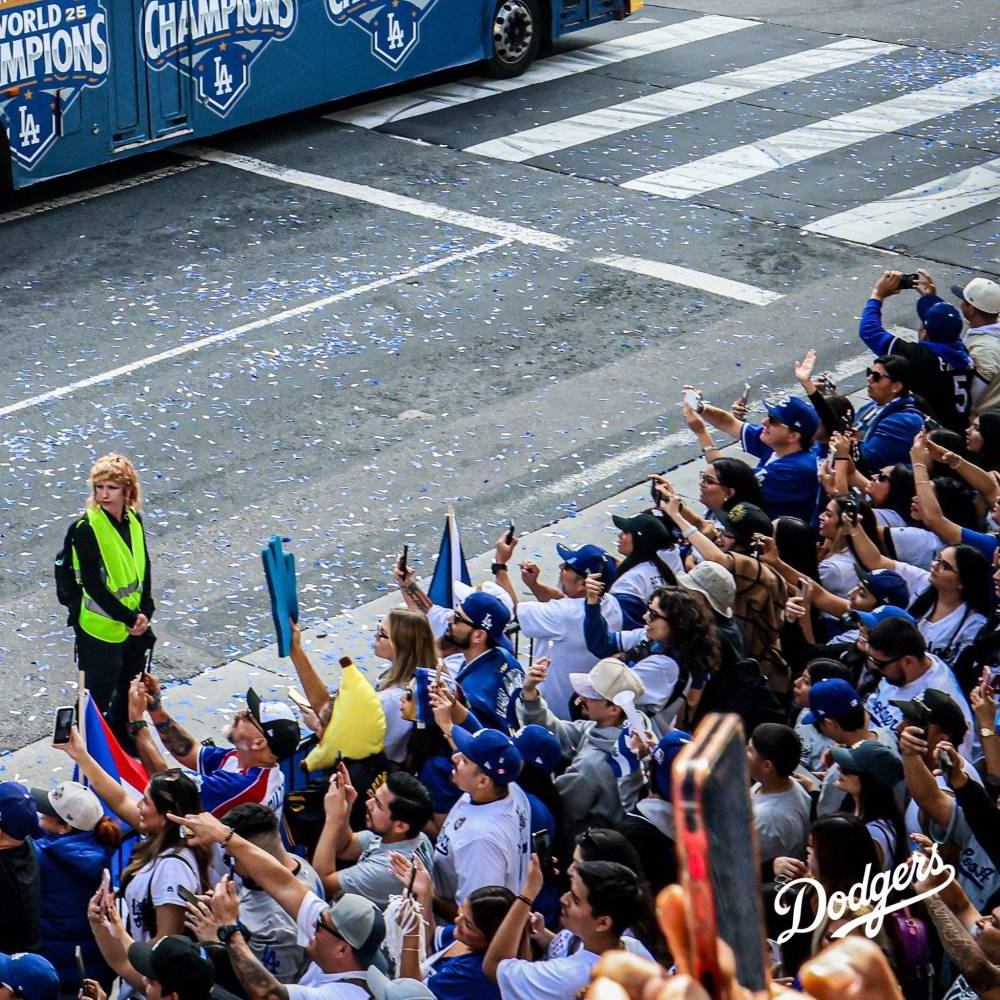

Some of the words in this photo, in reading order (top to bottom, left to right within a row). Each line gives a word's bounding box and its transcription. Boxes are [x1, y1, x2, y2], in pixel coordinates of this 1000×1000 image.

[65, 5, 87, 22] 25
[387, 12, 404, 50] LA
[213, 56, 233, 96] LA
[18, 105, 40, 148] LA
[953, 375, 968, 413] 5
